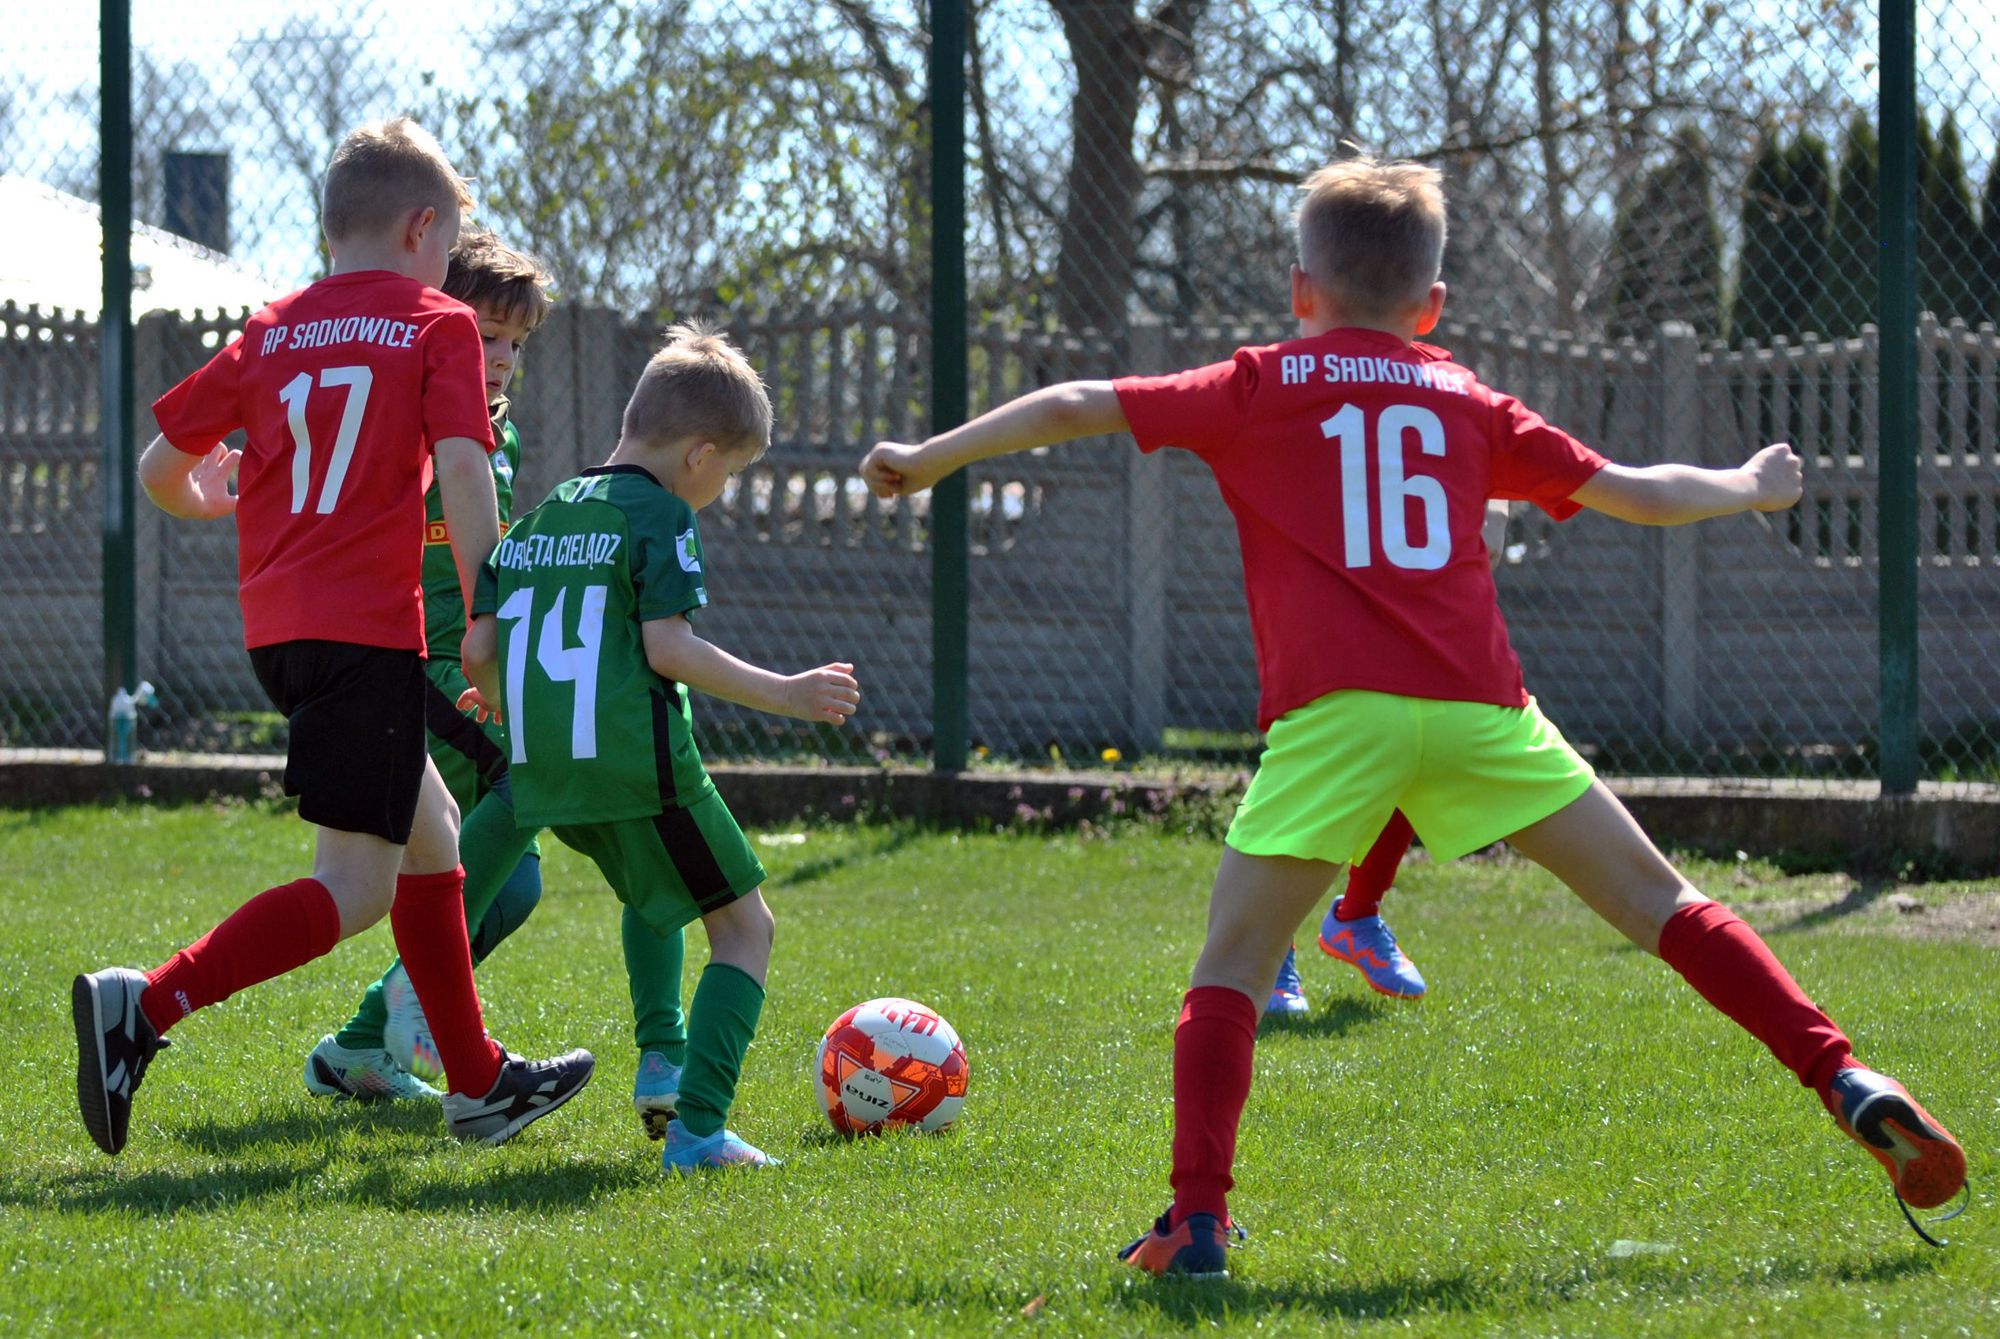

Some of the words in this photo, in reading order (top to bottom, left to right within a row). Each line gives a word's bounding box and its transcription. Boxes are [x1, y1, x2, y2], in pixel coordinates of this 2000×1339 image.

[261, 325, 288, 357] AP
[289, 316, 419, 349] SADKOWICE
[1281, 354, 1316, 385] AP
[1323, 353, 1469, 396] SADKOWICE
[279, 365, 374, 515] 17
[1320, 402, 1452, 571] 16
[556, 532, 622, 571] CIELĄDZ
[496, 585, 608, 765] 14
